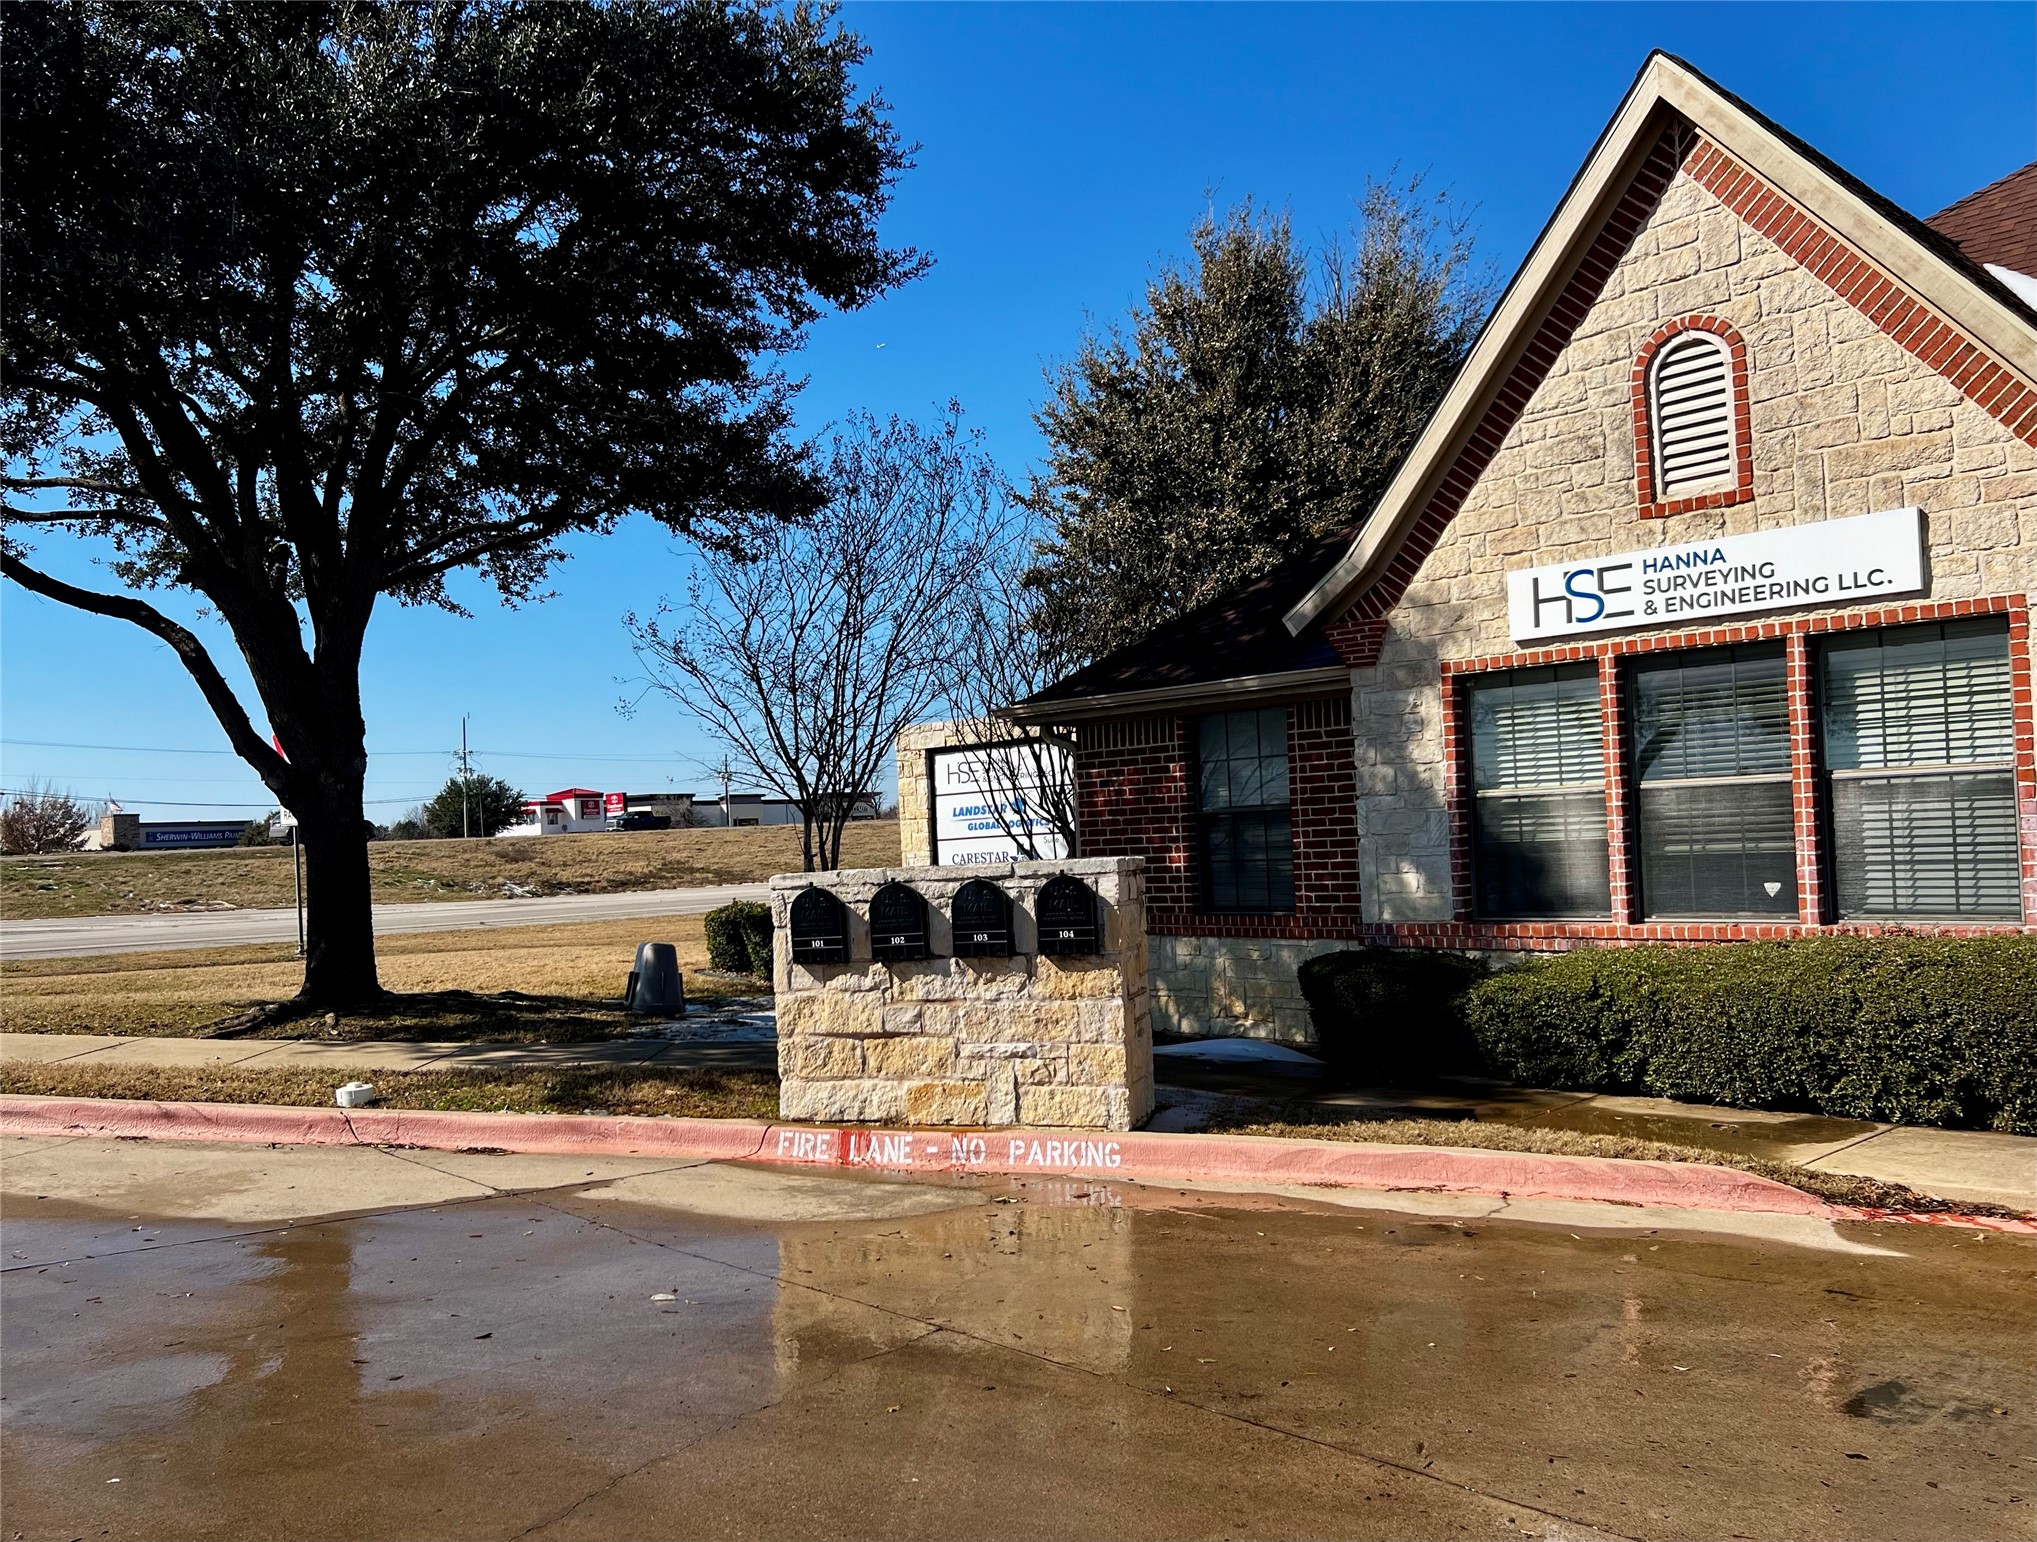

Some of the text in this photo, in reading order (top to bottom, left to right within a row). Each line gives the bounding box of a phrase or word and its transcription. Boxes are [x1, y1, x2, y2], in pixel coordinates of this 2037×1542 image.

[1642, 547, 1727, 575] HANNA
[1643, 562, 1775, 596] SURVEYING
[1643, 568, 1893, 615] & ENGINEERING LLC.
[968, 822, 1001, 831] GLOBAL
[952, 850, 1010, 865] CARESTAR
[973, 934, 988, 942] 103
[1059, 930, 1074, 938] 104
[811, 940, 824, 948] 101
[777, 1130, 831, 1160] FIRE
[850, 1131, 914, 1164] LANE
[951, 1135, 986, 1165] NO
[1009, 1138, 1122, 1168] PARKING
